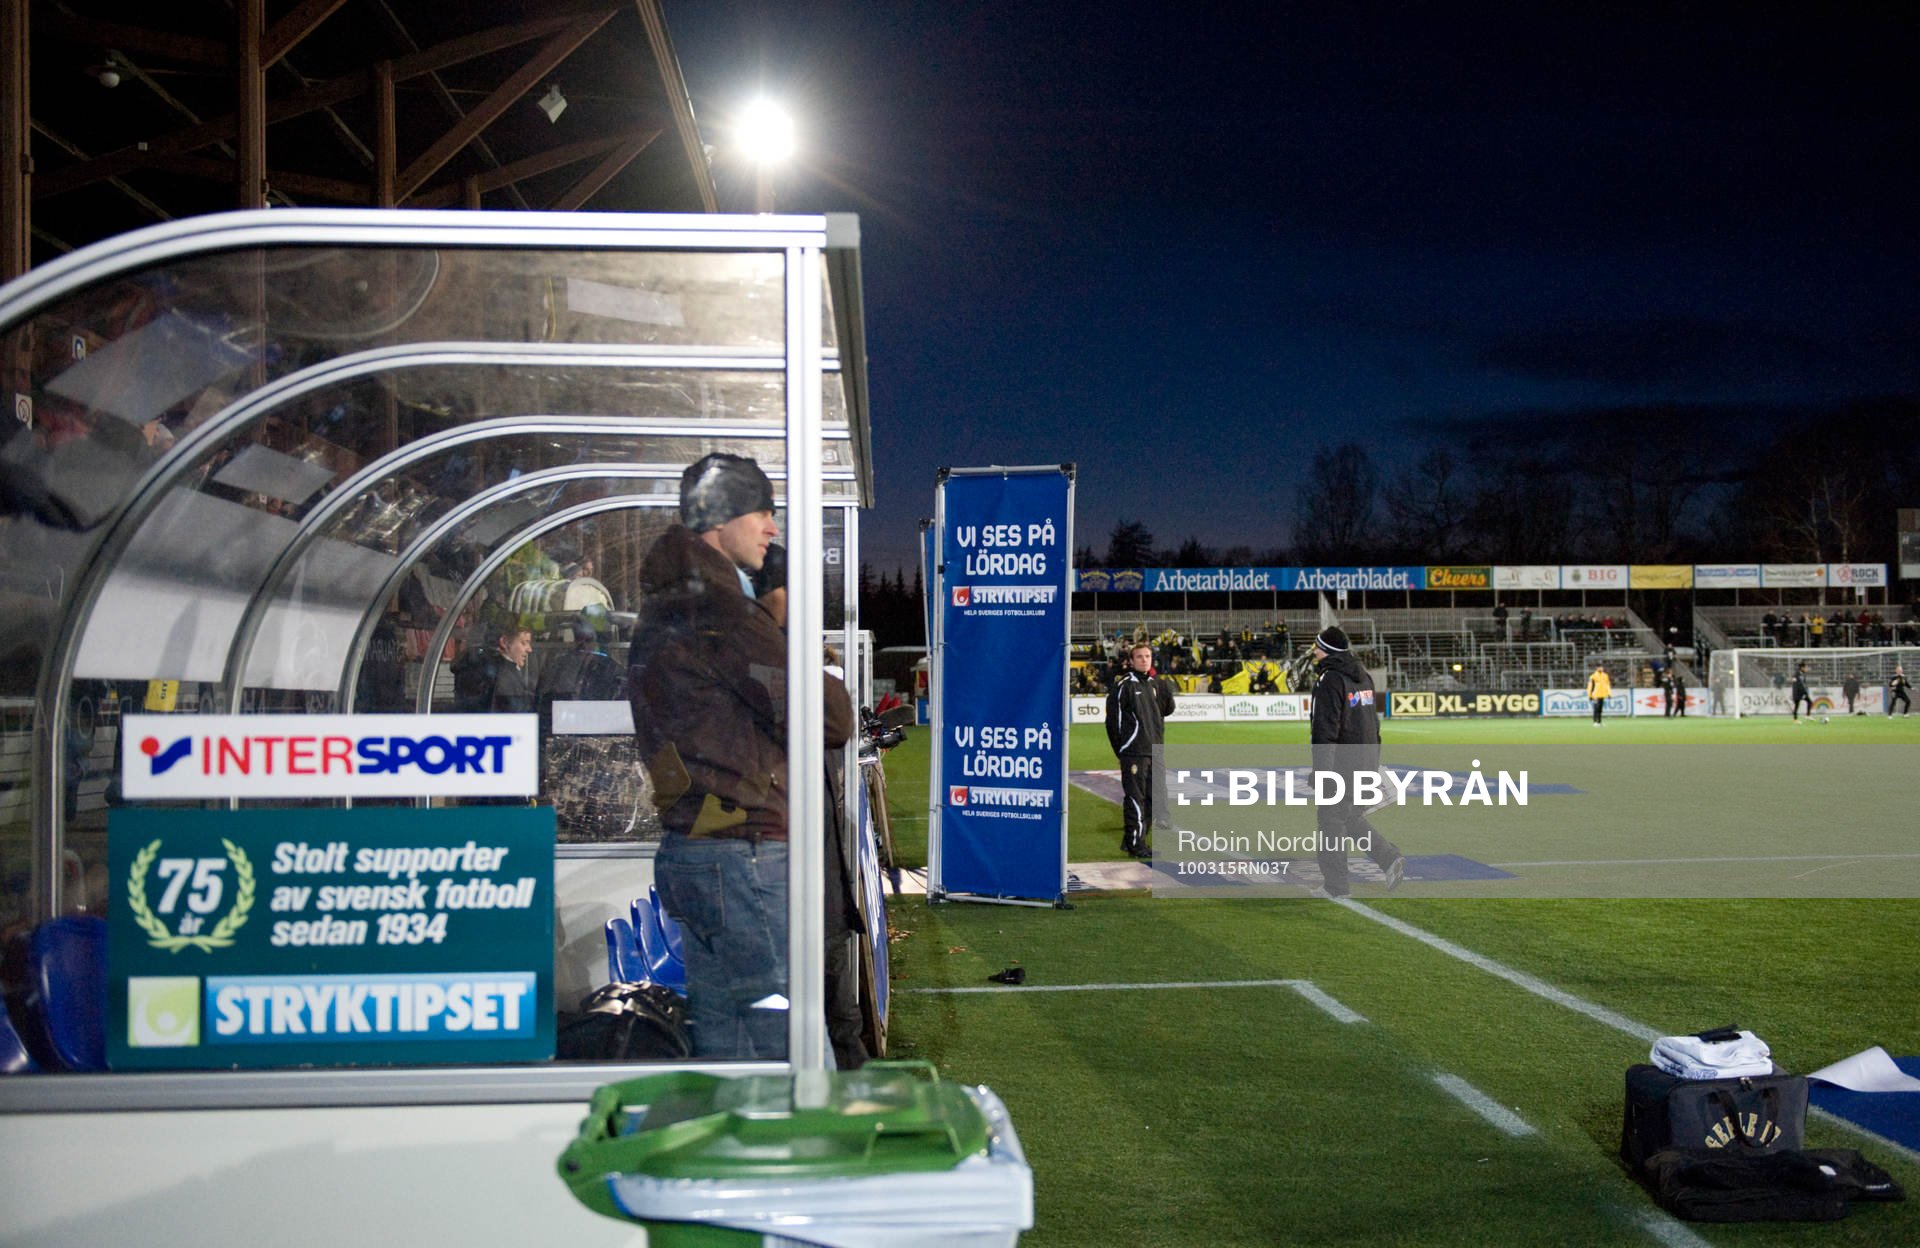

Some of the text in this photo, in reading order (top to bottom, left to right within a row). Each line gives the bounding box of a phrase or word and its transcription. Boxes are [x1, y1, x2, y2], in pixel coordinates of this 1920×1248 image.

[957, 518, 1056, 548] VI SES PÅ
[966, 548, 1047, 576] LÖRDAG
[1587, 569, 1617, 581] BIG
[1430, 568, 1487, 588] Cheers
[972, 588, 1056, 604] STRYKTIPSET
[1078, 705, 1100, 716] sto
[1438, 695, 1540, 713] XL-BYGG
[955, 721, 1052, 751] VI SES PÅ
[202, 735, 512, 777] INTERSPORT
[963, 749, 1043, 779] LÖRDAG
[970, 789, 1051, 808] STRYKTIPSET
[271, 840, 509, 880] Stolt supporter
[157, 857, 228, 914] 75
[270, 877, 537, 912] av svensk fotboll
[178, 911, 206, 935] år
[270, 913, 449, 947] sedan 1934
[215, 982, 528, 1036] STRYKTIPSET
